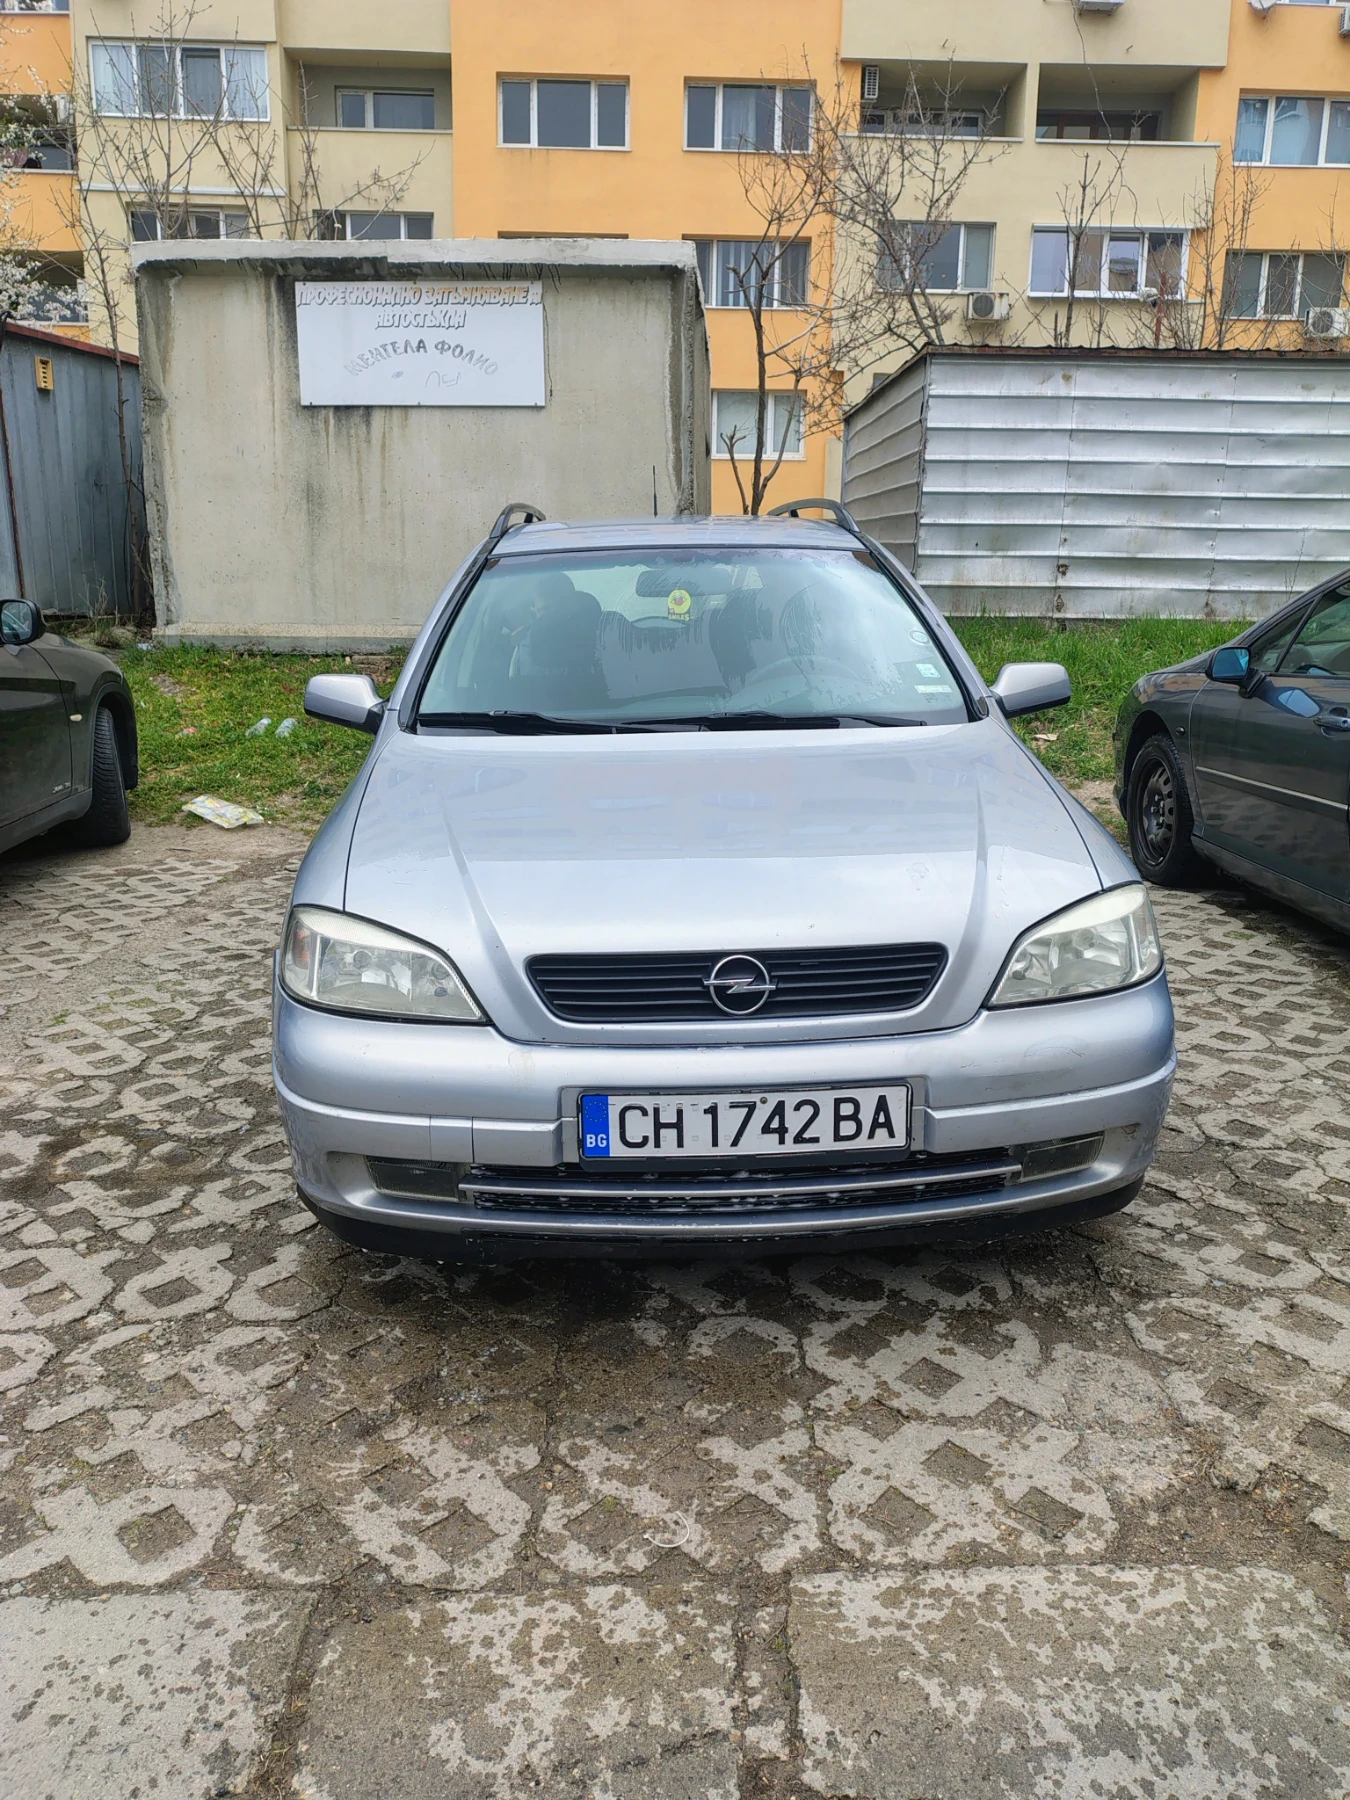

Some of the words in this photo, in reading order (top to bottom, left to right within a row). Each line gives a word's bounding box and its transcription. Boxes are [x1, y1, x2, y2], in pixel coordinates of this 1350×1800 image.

[434, 339, 499, 376] ФОЛИО
[586, 1133, 607, 1148] BG
[703, 1099, 821, 1148] 1742
